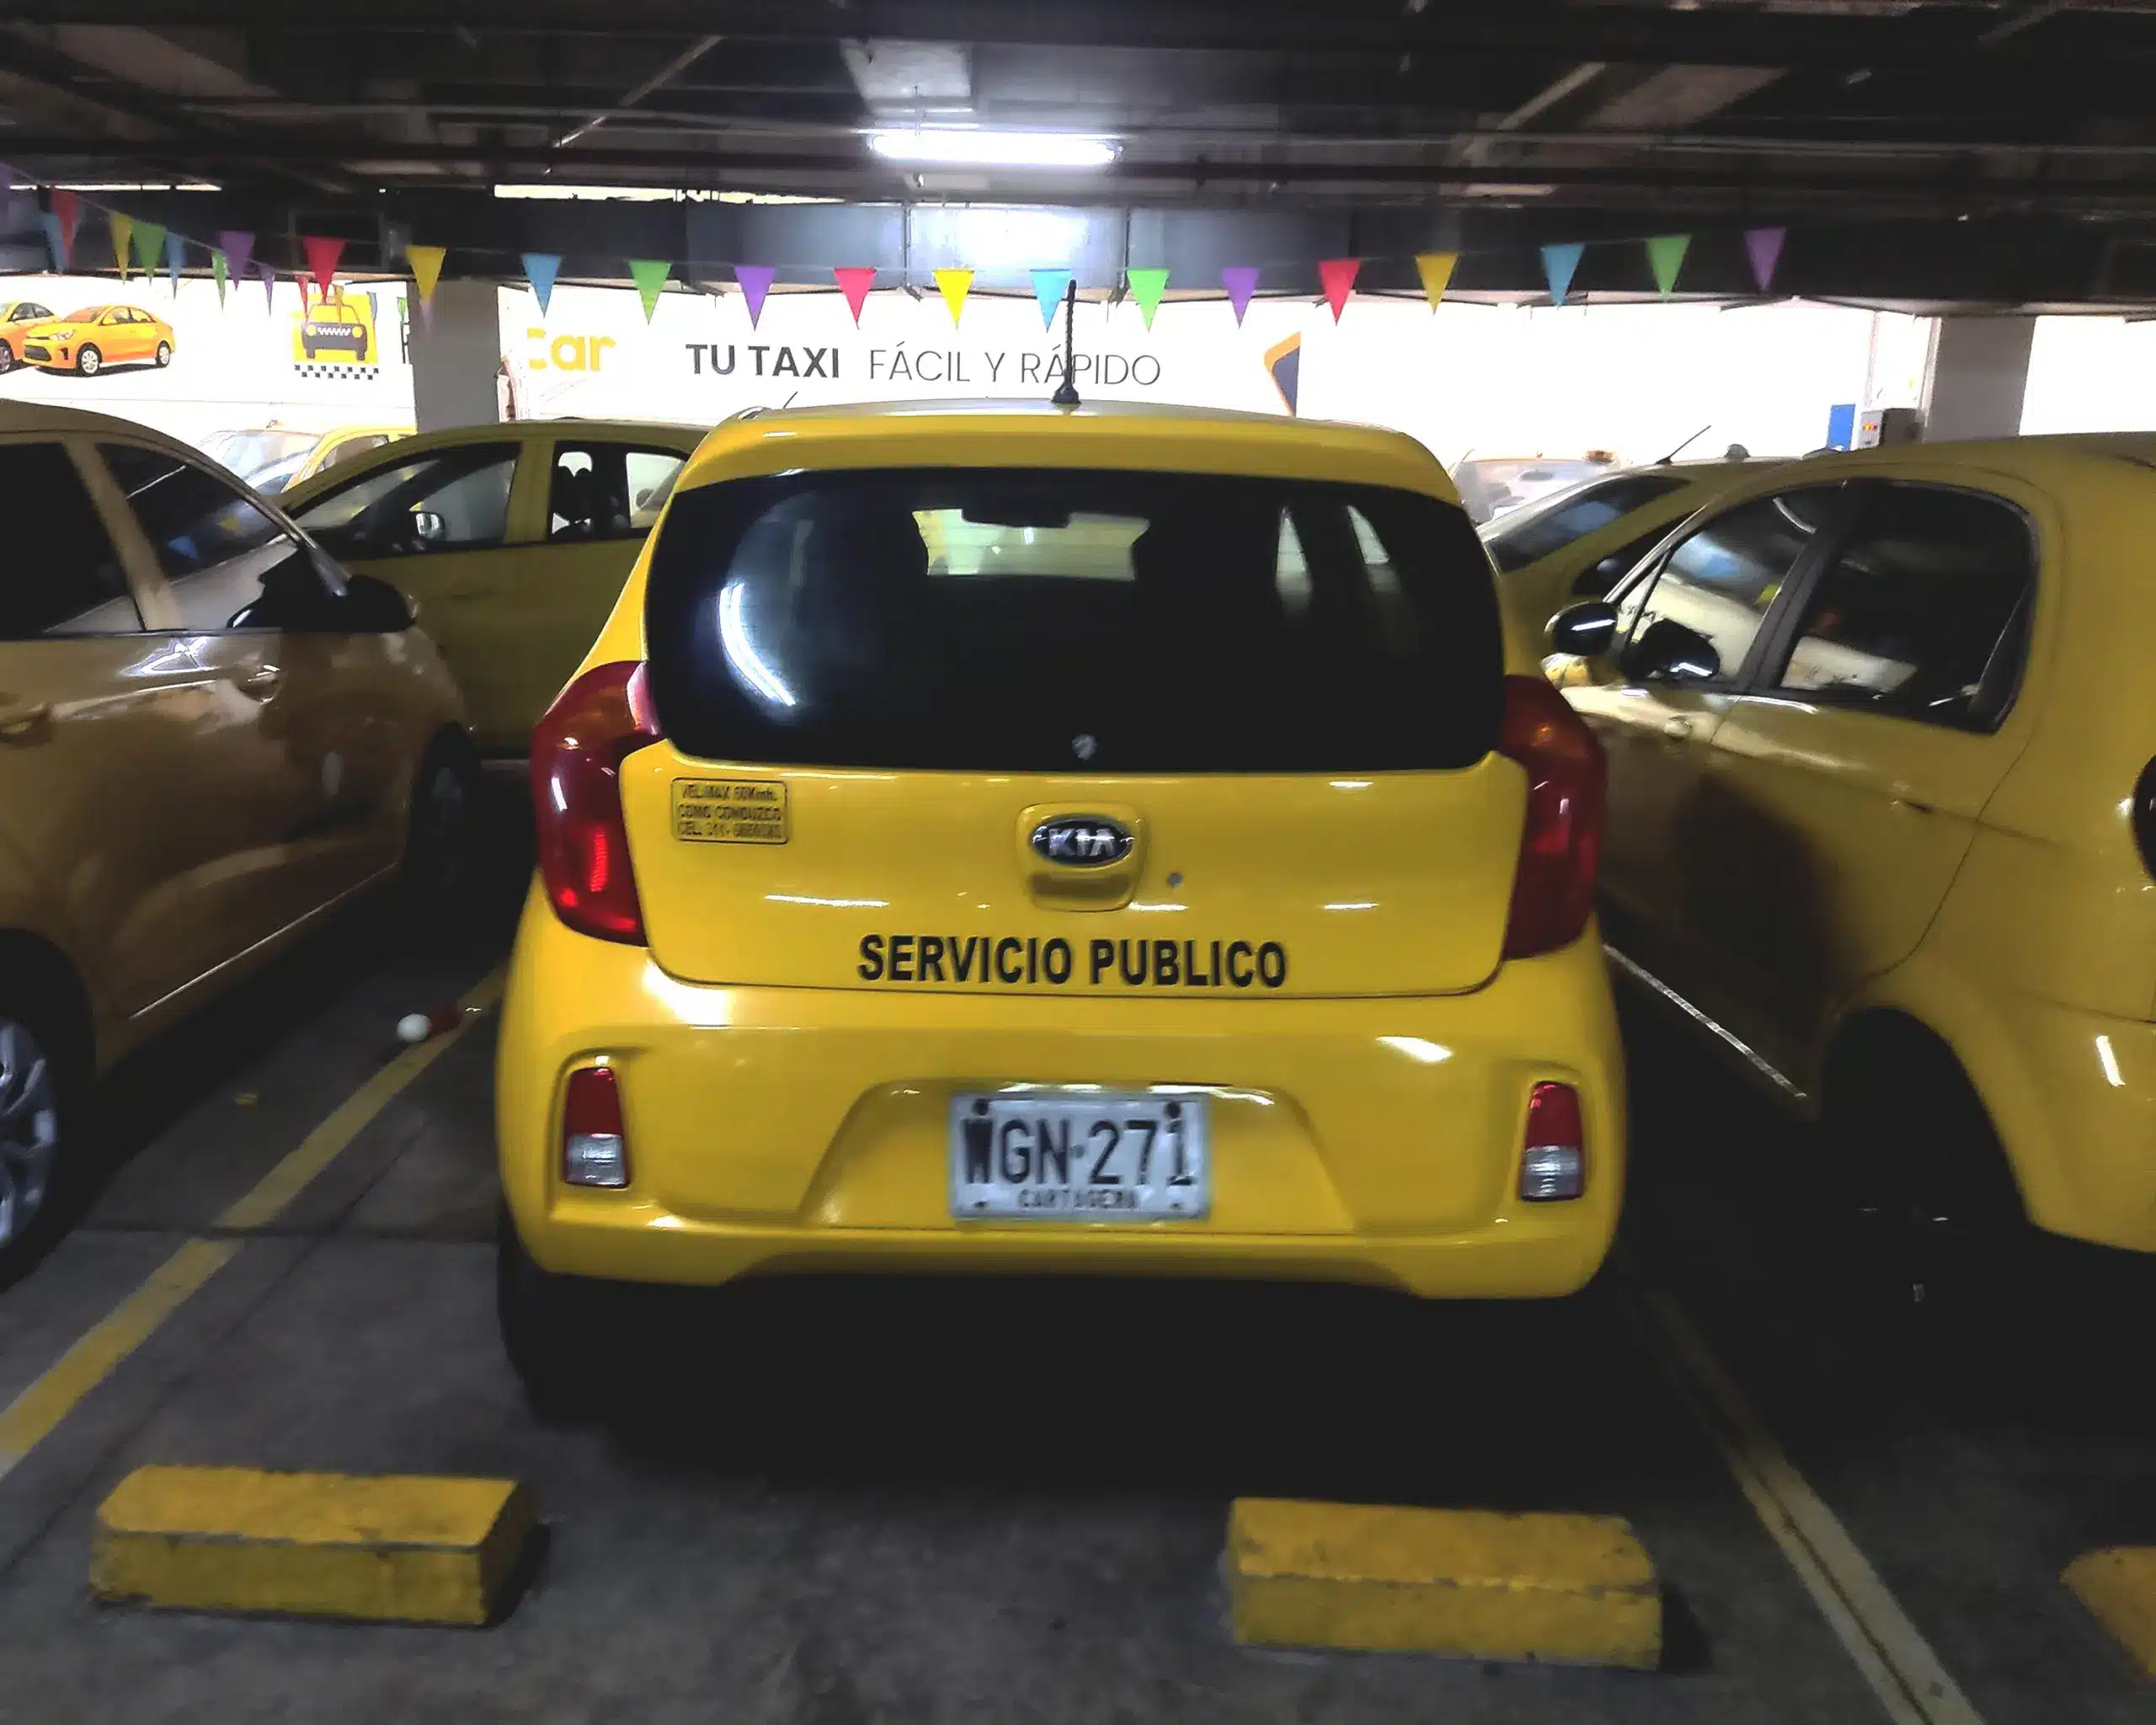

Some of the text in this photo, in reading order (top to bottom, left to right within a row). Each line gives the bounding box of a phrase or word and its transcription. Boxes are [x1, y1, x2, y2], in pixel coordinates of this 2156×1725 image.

[686, 340, 1161, 385] TU TAXI FÁCIL Y RÁPIDO
[1048, 828, 1117, 857] KIA
[857, 933, 1287, 988] SERVICIO PUBLICO
